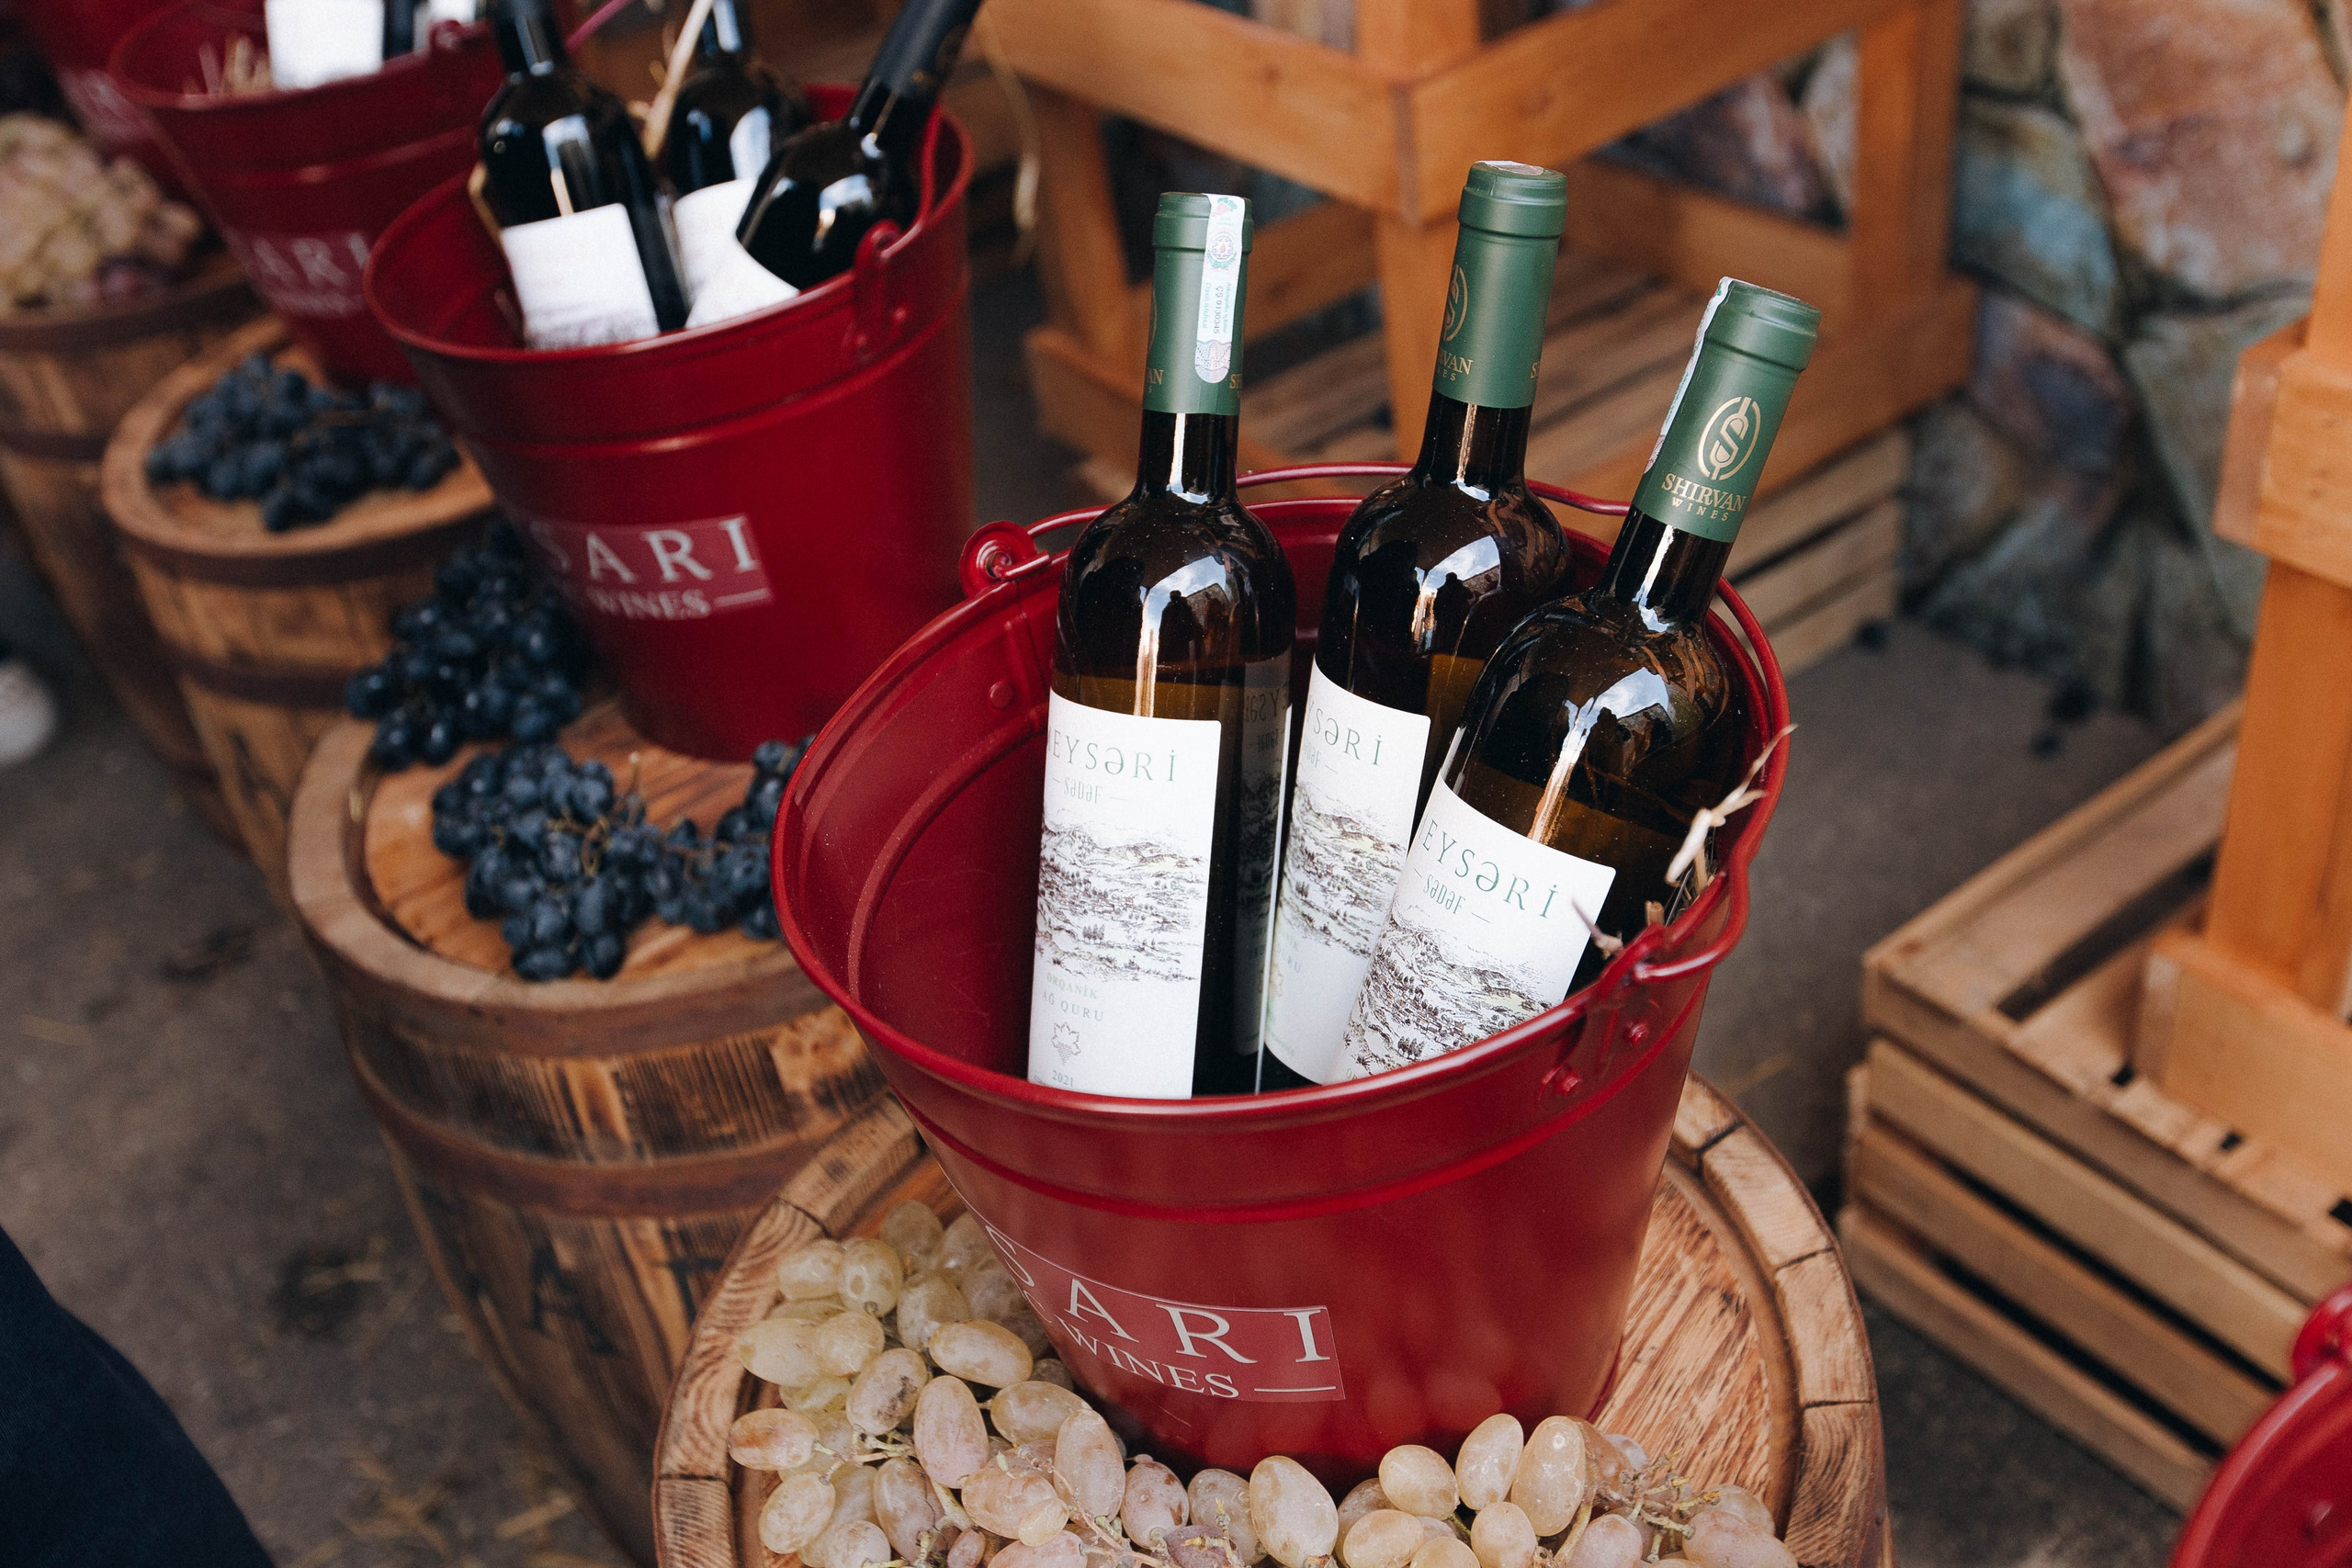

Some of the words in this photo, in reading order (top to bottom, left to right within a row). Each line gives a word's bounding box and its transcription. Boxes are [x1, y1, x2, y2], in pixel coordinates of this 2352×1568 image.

[1661, 472, 1747, 513] SHIRVAN
[1672, 497, 1729, 522] WINES
[1048, 726, 1175, 782] EYSƏRİ
[1306, 694, 1383, 767] YSƏRİ
[1061, 1000, 1103, 1021] QURU
[1052, 1070, 1074, 1088] 2021
[985, 1225, 1331, 1364] SARI
[1055, 1314, 1239, 1398] WINES
